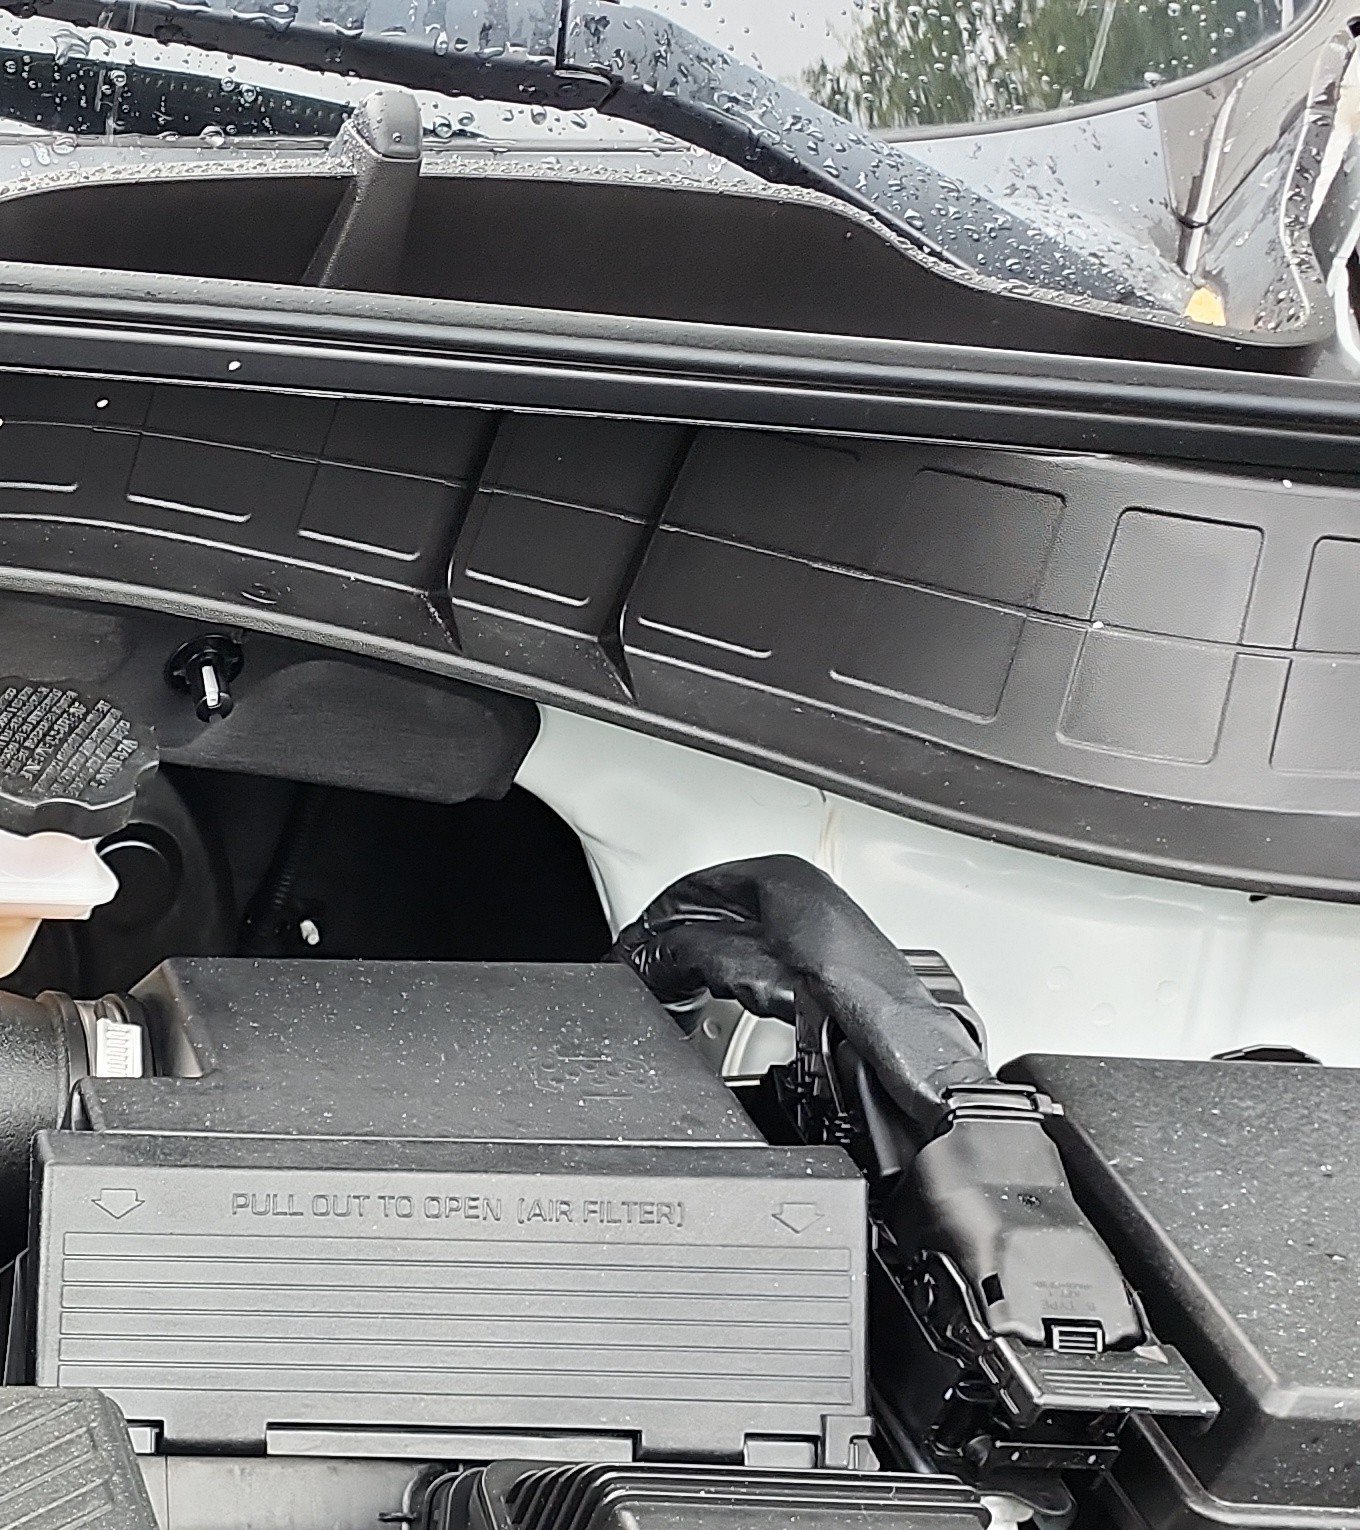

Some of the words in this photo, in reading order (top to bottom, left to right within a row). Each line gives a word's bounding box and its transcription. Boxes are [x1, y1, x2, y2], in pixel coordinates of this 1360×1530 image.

[231, 1193, 304, 1218] PULL
[311, 1194, 370, 1219] OUT
[375, 1195, 416, 1220] TO
[424, 1196, 502, 1222] OPEN
